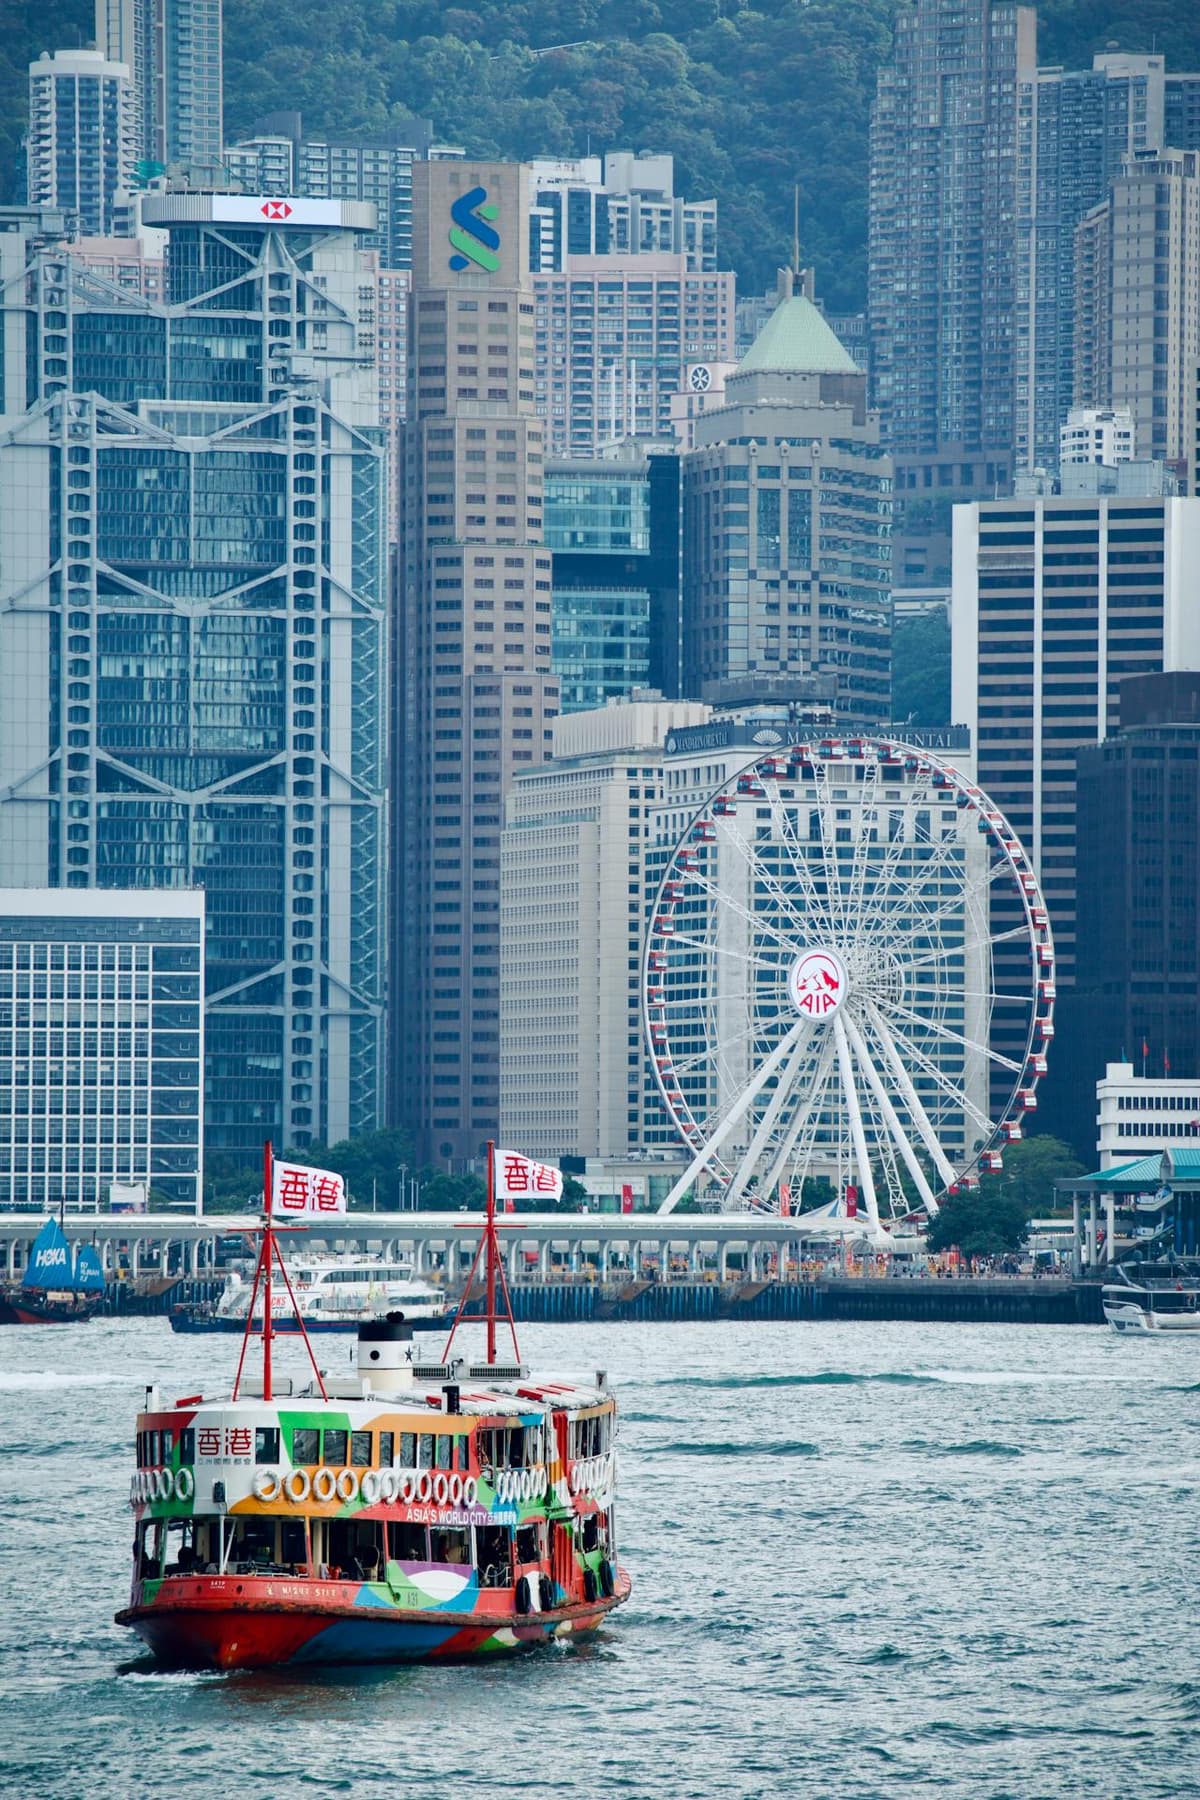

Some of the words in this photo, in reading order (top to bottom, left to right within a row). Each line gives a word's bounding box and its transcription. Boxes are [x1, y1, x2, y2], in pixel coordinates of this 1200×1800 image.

[799, 993, 837, 1013] AIA
[504, 1156, 557, 1192] 香港
[280, 1170, 340, 1211] 香港
[35, 1248, 66, 1267] HOKA
[198, 1428, 251, 1455] 香港
[406, 1508, 437, 1522] ASIA'S
[439, 1510, 469, 1524] WORLD
[469, 1511, 487, 1525] CITY
